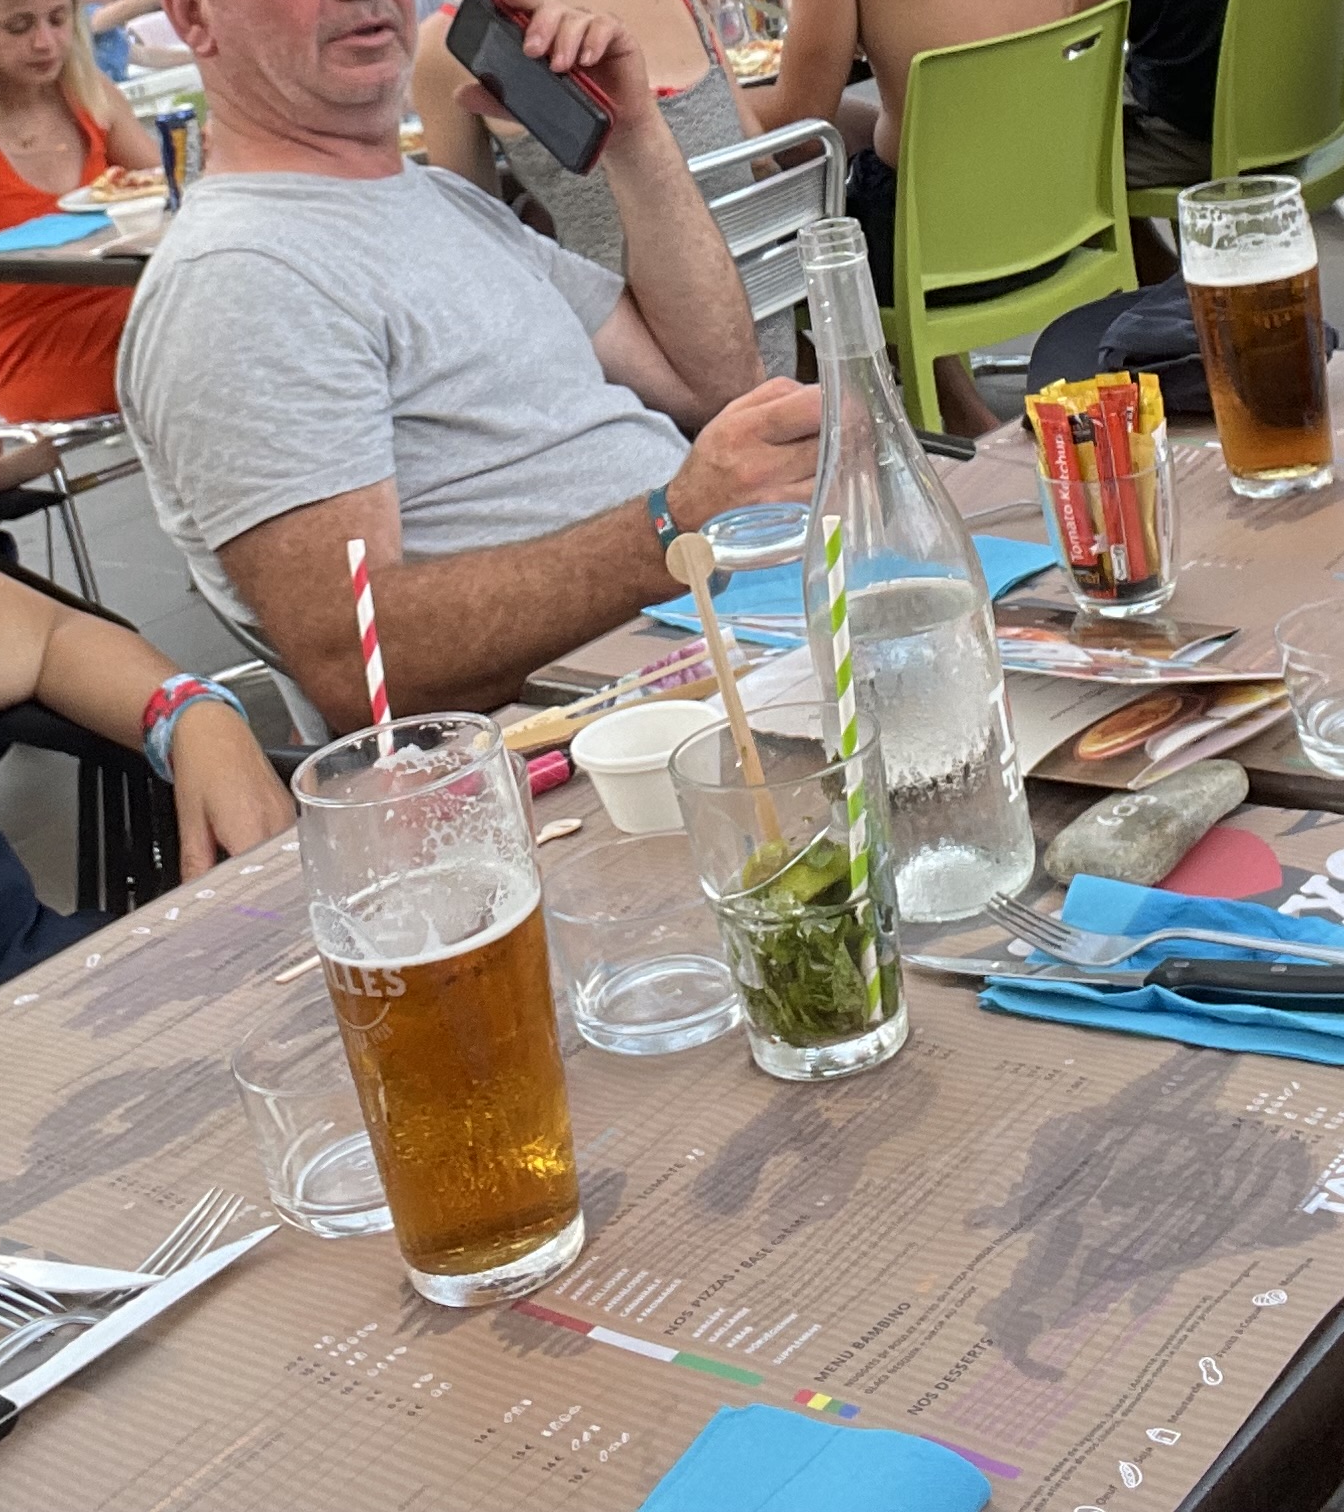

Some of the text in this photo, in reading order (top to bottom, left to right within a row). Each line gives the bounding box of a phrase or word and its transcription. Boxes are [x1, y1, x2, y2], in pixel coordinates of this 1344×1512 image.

[1054, 434, 1085, 563] Tomato Ketchup
[663, 1308, 693, 1334] NOS
[691, 1273, 734, 1305] PIZZAS
[740, 1247, 772, 1268] BASE
[814, 1303, 911, 1381] MENU BAMBINO
[907, 1338, 993, 1414] NOS DESSERTS
